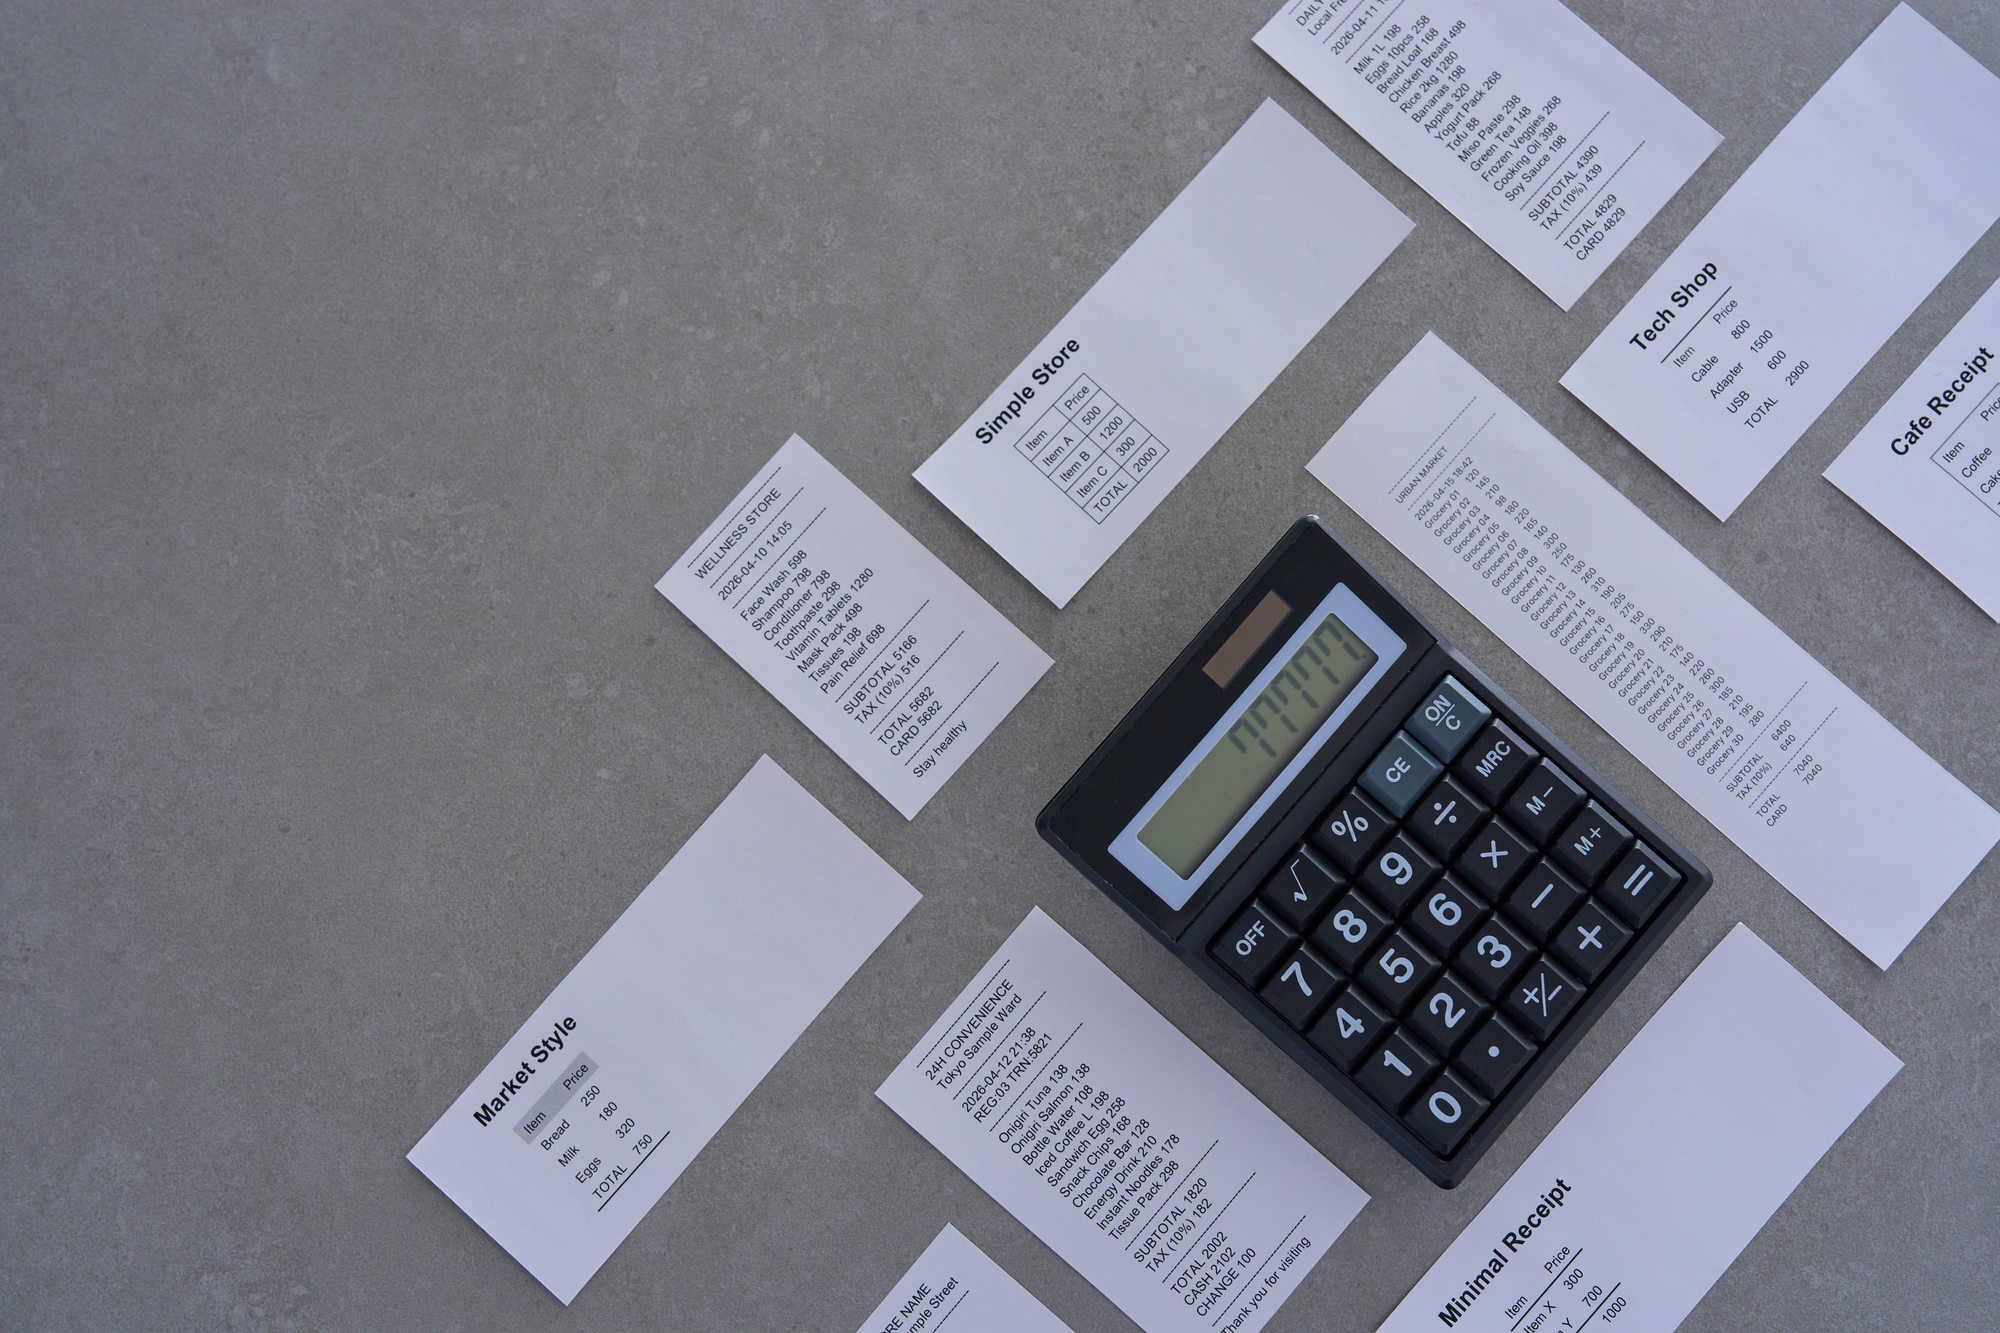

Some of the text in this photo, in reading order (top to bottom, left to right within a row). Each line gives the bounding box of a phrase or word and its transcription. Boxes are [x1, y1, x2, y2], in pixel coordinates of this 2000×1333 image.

[1306, 9, 1333, 36] Local
[1352, 23, 1402, 75] Milk 1L 198
[1364, 14, 1430, 85] Eggs 10pcs 258
[1388, 19, 1466, 103] Chicken Breast 498
[1480, 95, 1561, 182] Frozen Veggies 268
[1527, 145, 1599, 222] SUBTOTAL 4390
[1562, 193, 1617, 250] TOTAL 4829
[1628, 262, 1717, 350] Tech Shop
[1672, 299, 1738, 368] Item Price
[1691, 319, 1751, 383] Cable 800
[1709, 329, 1773, 400] Adapter 1500
[1725, 349, 1787, 414] USB 600
[974, 339, 1080, 445] Simple Store
[1024, 385, 1090, 451] Item Price
[1743, 360, 1810, 429] TOTAL 2900
[1890, 346, 1995, 456] Cafe Receipt
[1041, 405, 1101, 467] Item A 500
[1059, 415, 1123, 483] Item B 1200
[1075, 436, 1136, 498] Item C 300
[1941, 441, 1965, 463] Item
[1961, 447, 1992, 478] Coffee
[1092, 446, 1158, 512] TOTAL 2000
[1394, 445, 1448, 504] URBAN MARKET
[1414, 456, 1474, 521] 2026-04-15 18:42
[1424, 468, 1480, 529] Grocery 01 120
[694, 487, 782, 579] WELLNESS STORE
[717, 520, 792, 601] 2026-04-10 14:05
[763, 569, 831, 641] Conditioner 798
[773, 580, 841, 651] Toothpaste 298
[784, 567, 874, 661] Vitamin Tablets 1280
[1559, 584, 1615, 647] Grocery 15 190
[819, 623, 886, 694] Pain Relief 698
[843, 634, 917, 715] SUBTOTAL 5166
[876, 685, 935, 745] TOTAL 5682
[1426, 694, 1450, 721] ON
[1445, 715, 1461, 730] C
[912, 720, 967, 778] Stay healthy
[1386, 757, 1411, 783] CE
[1476, 741, 1510, 777] MRC
[1706, 710, 1765, 775] Grocery 30 280
[1755, 754, 1813, 818] TOTAL 7040
[1332, 811, 1369, 842] %
[1574, 827, 1601, 856] M+
[1380, 852, 1413, 885] 9
[1237, 921, 1265, 955] OFF
[1334, 909, 1367, 943] 8
[1430, 893, 1462, 926] 6
[1281, 961, 1313, 996] 7
[1380, 948, 1414, 983] 5
[1478, 935, 1512, 968] 3
[924, 978, 1014, 1081] 24H CONVENIENCE
[935, 992, 1022, 1090] Tokyo Sample Ward
[1336, 1007, 1365, 1039] 4
[1430, 992, 1466, 1028] 2
[472, 1016, 577, 1128] Market Style
[972, 1032, 1052, 1123] REG:03 TRN:5821
[1383, 1050, 1412, 1076] 1
[522, 1064, 589, 1135] Item Price
[540, 1084, 601, 1151] Bread 250
[1010, 1062, 1091, 1154] Onigiri Salmon 138
[1429, 1091, 1461, 1123] 0
[557, 1100, 618, 1168] Milk 180
[574, 1117, 635, 1184] Eggs 320
[591, 1133, 653, 1199] TOTAL 750
[1095, 1133, 1180, 1231] Instant Noodles 178
[1133, 1177, 1208, 1263] SUBTOTAL 1820
[1437, 1177, 1572, 1328] Minimal Receipt
[899, 1282, 932, 1319] NAME
[928, 1276, 959, 1309] Street
[1183, 1246, 1236, 1306] CASH 2102
[1196, 1247, 1256, 1317] CHANGE 100
[1219, 1236, 1312, 1333] Thank you for visiting
[1504, 1246, 1571, 1320] Item Price
[1522, 1268, 1584, 1333] Item X 300
[1561, 1316, 1573, 1329] Y
[1581, 1285, 1603, 1307] 700
[1602, 1296, 1627, 1323] 1000
